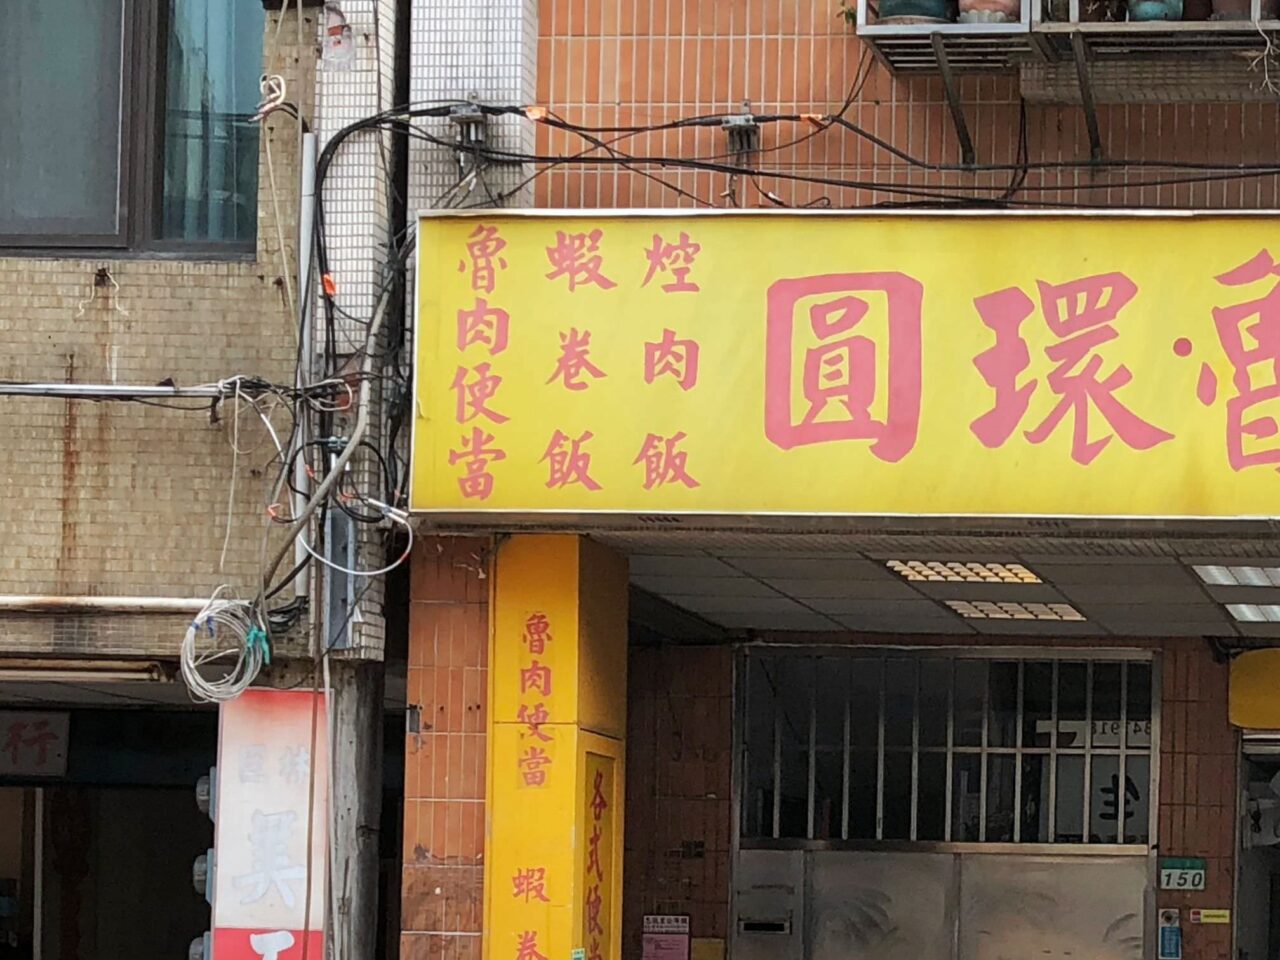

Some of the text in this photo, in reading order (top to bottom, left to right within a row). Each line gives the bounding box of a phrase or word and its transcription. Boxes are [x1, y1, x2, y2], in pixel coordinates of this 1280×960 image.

[448, 224, 511, 501] 魯肉便當
[539, 228, 617, 492] 蝦卷飯
[517, 613, 554, 787] 魯肉便當
[1164, 872, 1203, 888] 150
